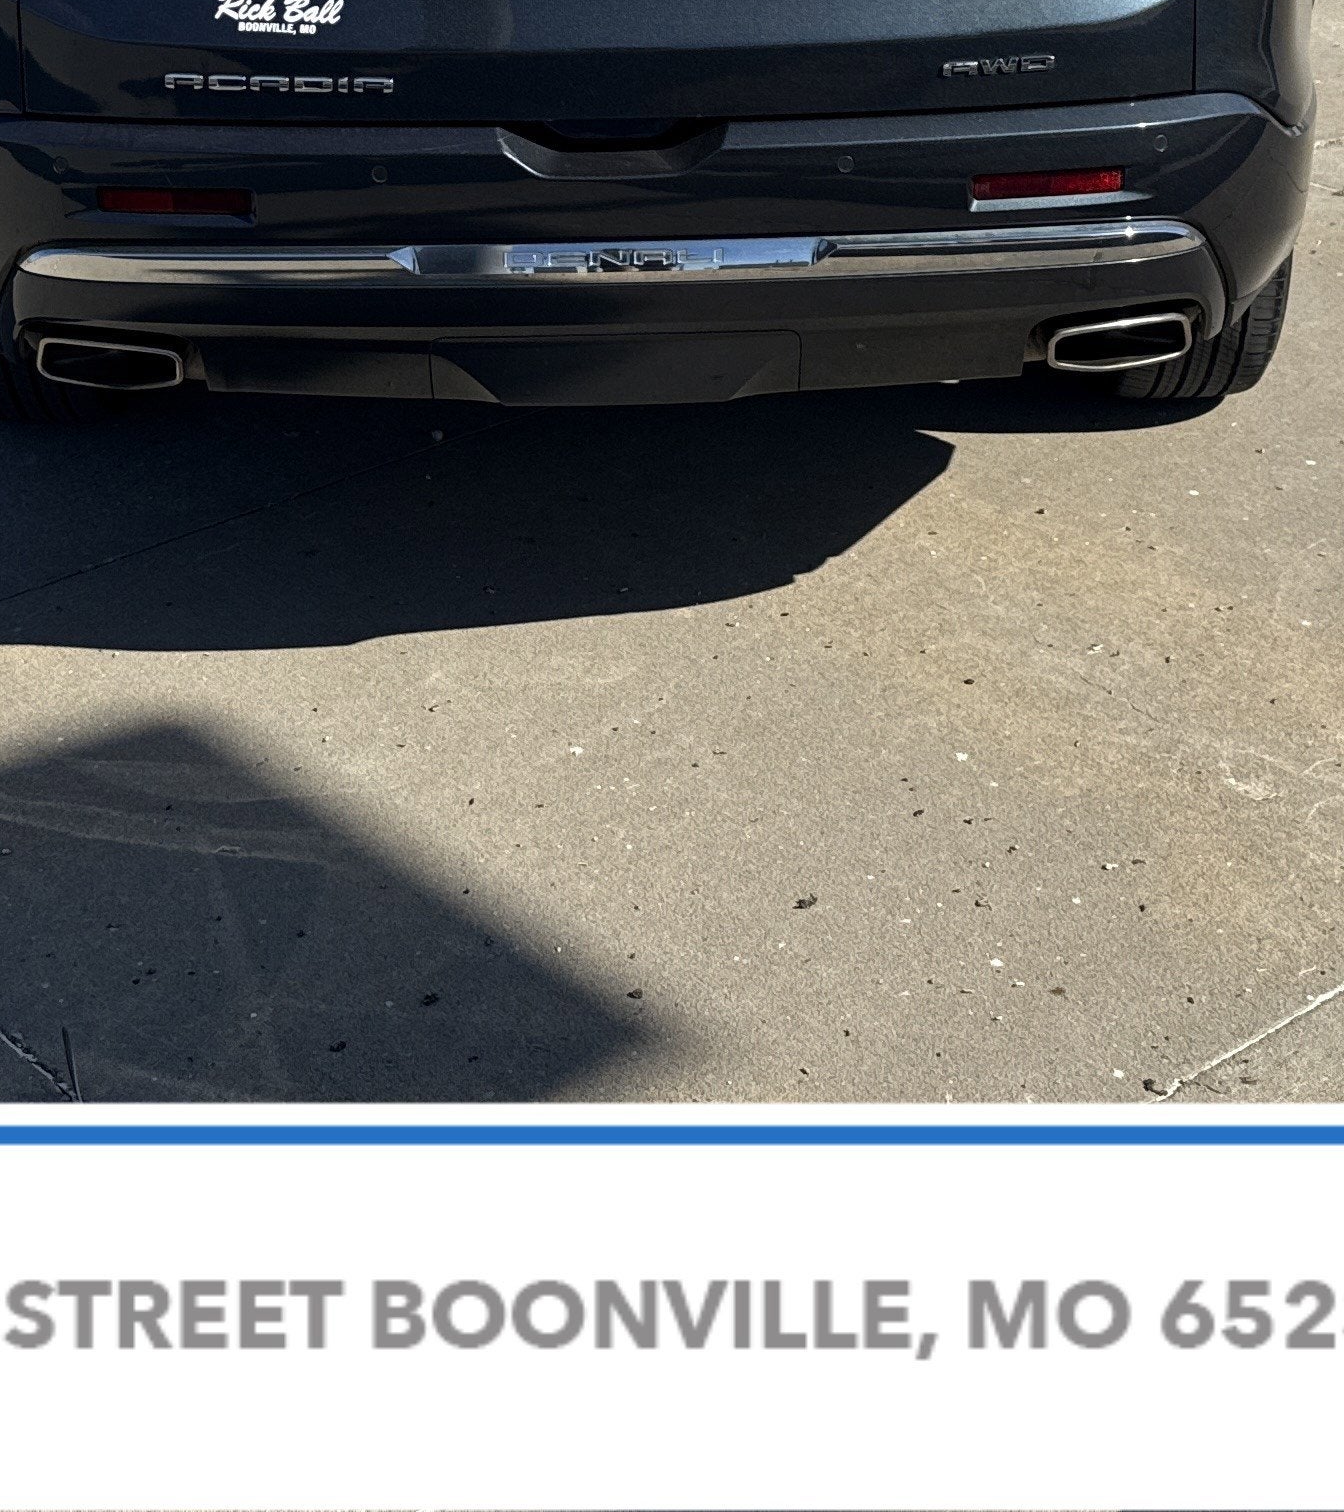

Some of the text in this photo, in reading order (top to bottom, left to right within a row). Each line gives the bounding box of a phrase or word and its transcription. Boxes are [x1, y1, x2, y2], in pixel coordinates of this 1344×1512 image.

[237, 21, 317, 35] BOONVILLE, MO
[941, 54, 1056, 79] AWD
[164, 73, 394, 93] ACADIA
[504, 247, 724, 269] DENALI
